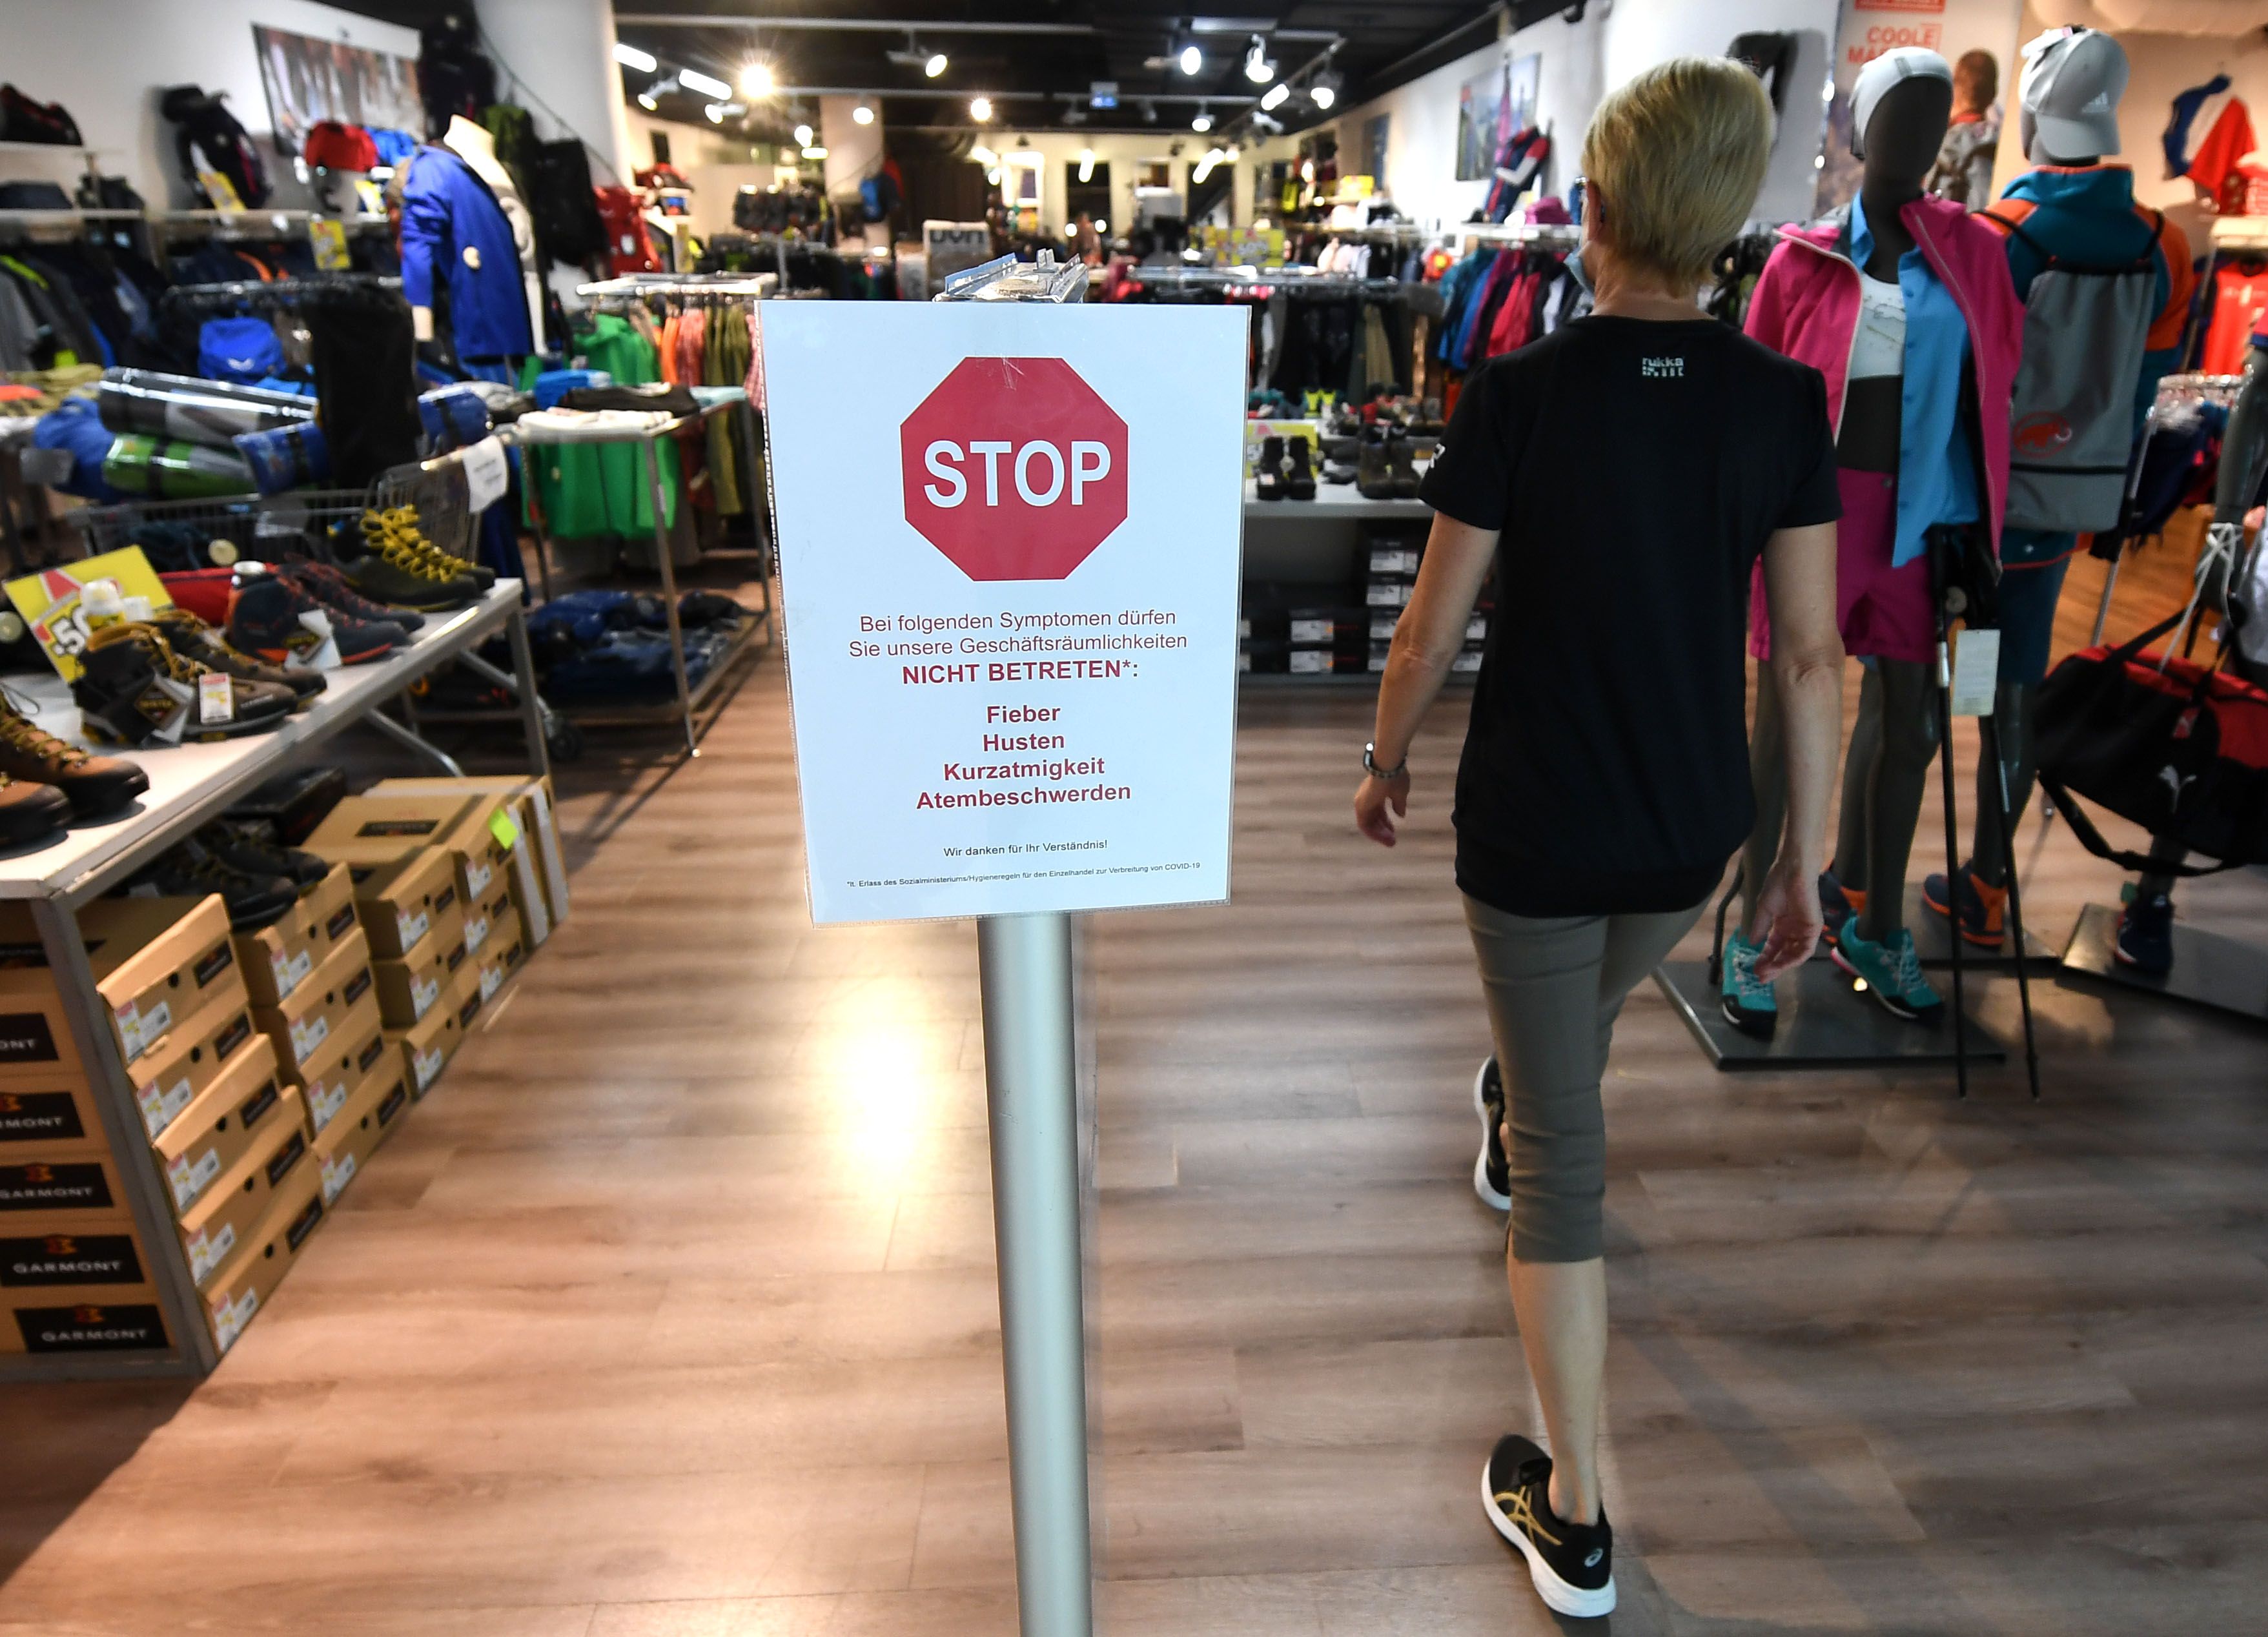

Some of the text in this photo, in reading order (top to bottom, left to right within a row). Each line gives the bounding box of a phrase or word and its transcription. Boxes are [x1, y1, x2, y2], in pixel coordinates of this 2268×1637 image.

[1867, 26, 1933, 47] COOLE
[924, 440, 1111, 508] STOP
[861, 609, 1176, 634] Bei folgenden Symptomen dürfen
[850, 633, 1187, 656] Sie unsere Geschäftsräumlichkeiten
[903, 664, 980, 684] NICHT
[986, 705, 1061, 724] Fieber
[983, 733, 1065, 751] Husten
[943, 757, 1105, 780] Kurzatmigkeit
[916, 784, 1130, 809] Atembeschwerden
[944, 840, 1107, 857] Wir danken für Ihr Verständnis!
[899, 872, 1021, 885] Sozialministeriums/Hygieneregeln
[1049, 868, 1094, 877] Einzelhandel
[1108, 866, 1149, 874] Verbreitung
[1165, 862, 1200, 871] COVID-19
[12, 1260, 121, 1274] GARMONT
[41, 1328, 147, 1342] GARMONT
